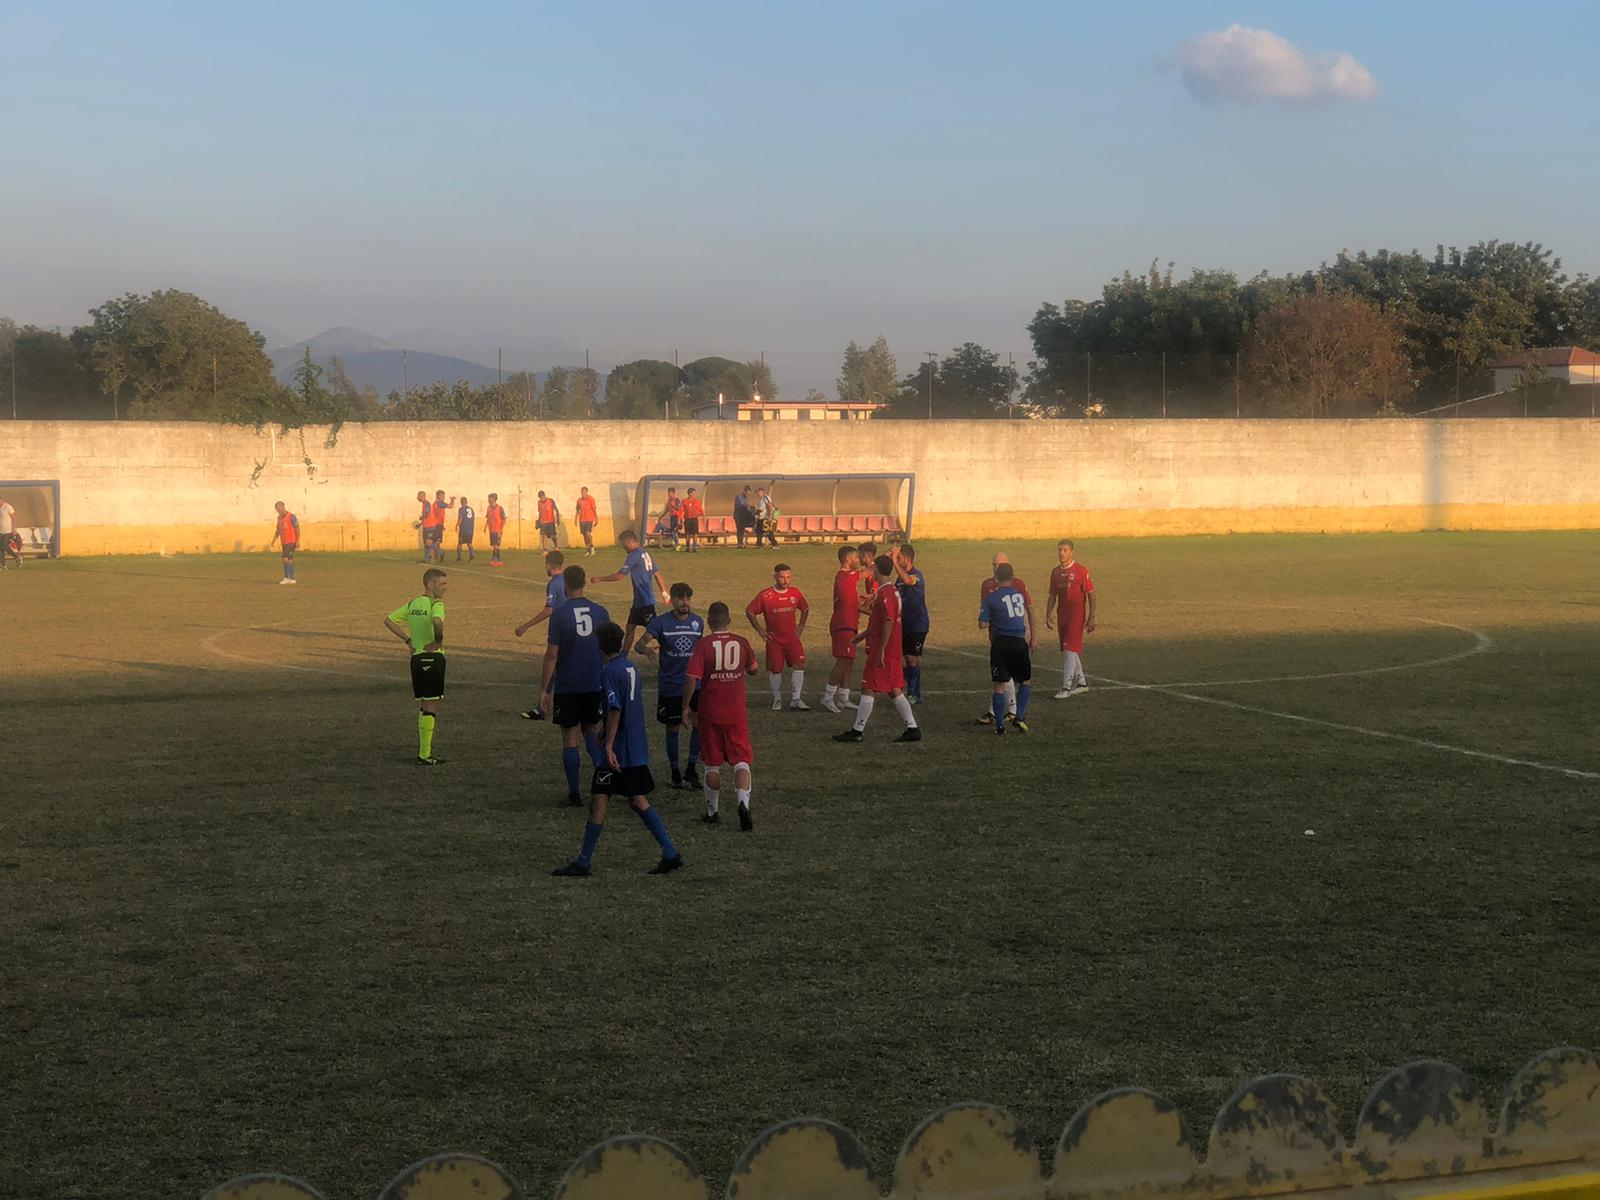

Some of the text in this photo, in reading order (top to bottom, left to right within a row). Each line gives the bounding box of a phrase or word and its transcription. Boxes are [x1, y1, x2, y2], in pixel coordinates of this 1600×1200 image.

[1001, 592, 1025, 618] 13
[573, 606, 593, 637] 5
[712, 640, 740, 671] 10
